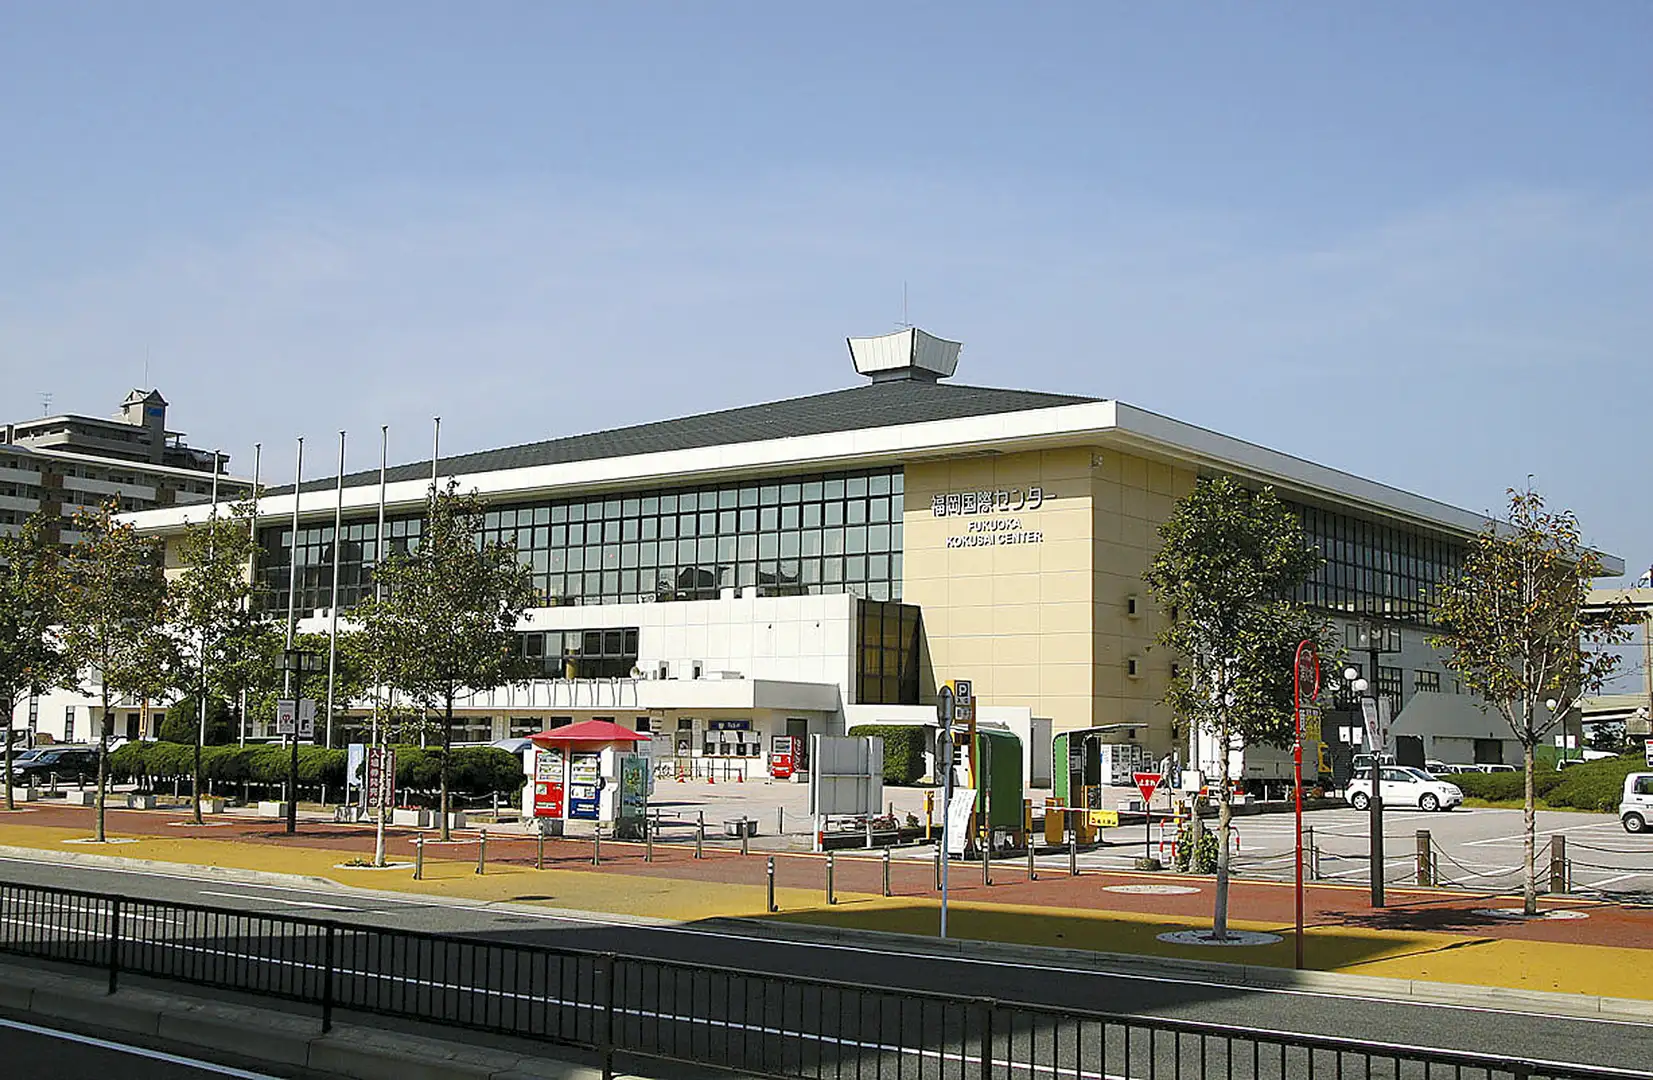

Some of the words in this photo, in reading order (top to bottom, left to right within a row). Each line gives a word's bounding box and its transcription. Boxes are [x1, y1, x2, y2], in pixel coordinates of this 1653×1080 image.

[931, 487, 1057, 517] 福岡国際センター
[968, 519, 1022, 533] FUKUOKA
[945, 533, 997, 548] KOKUSAI
[998, 532, 1044, 546] CENTER
[958, 684, 967, 696] P
